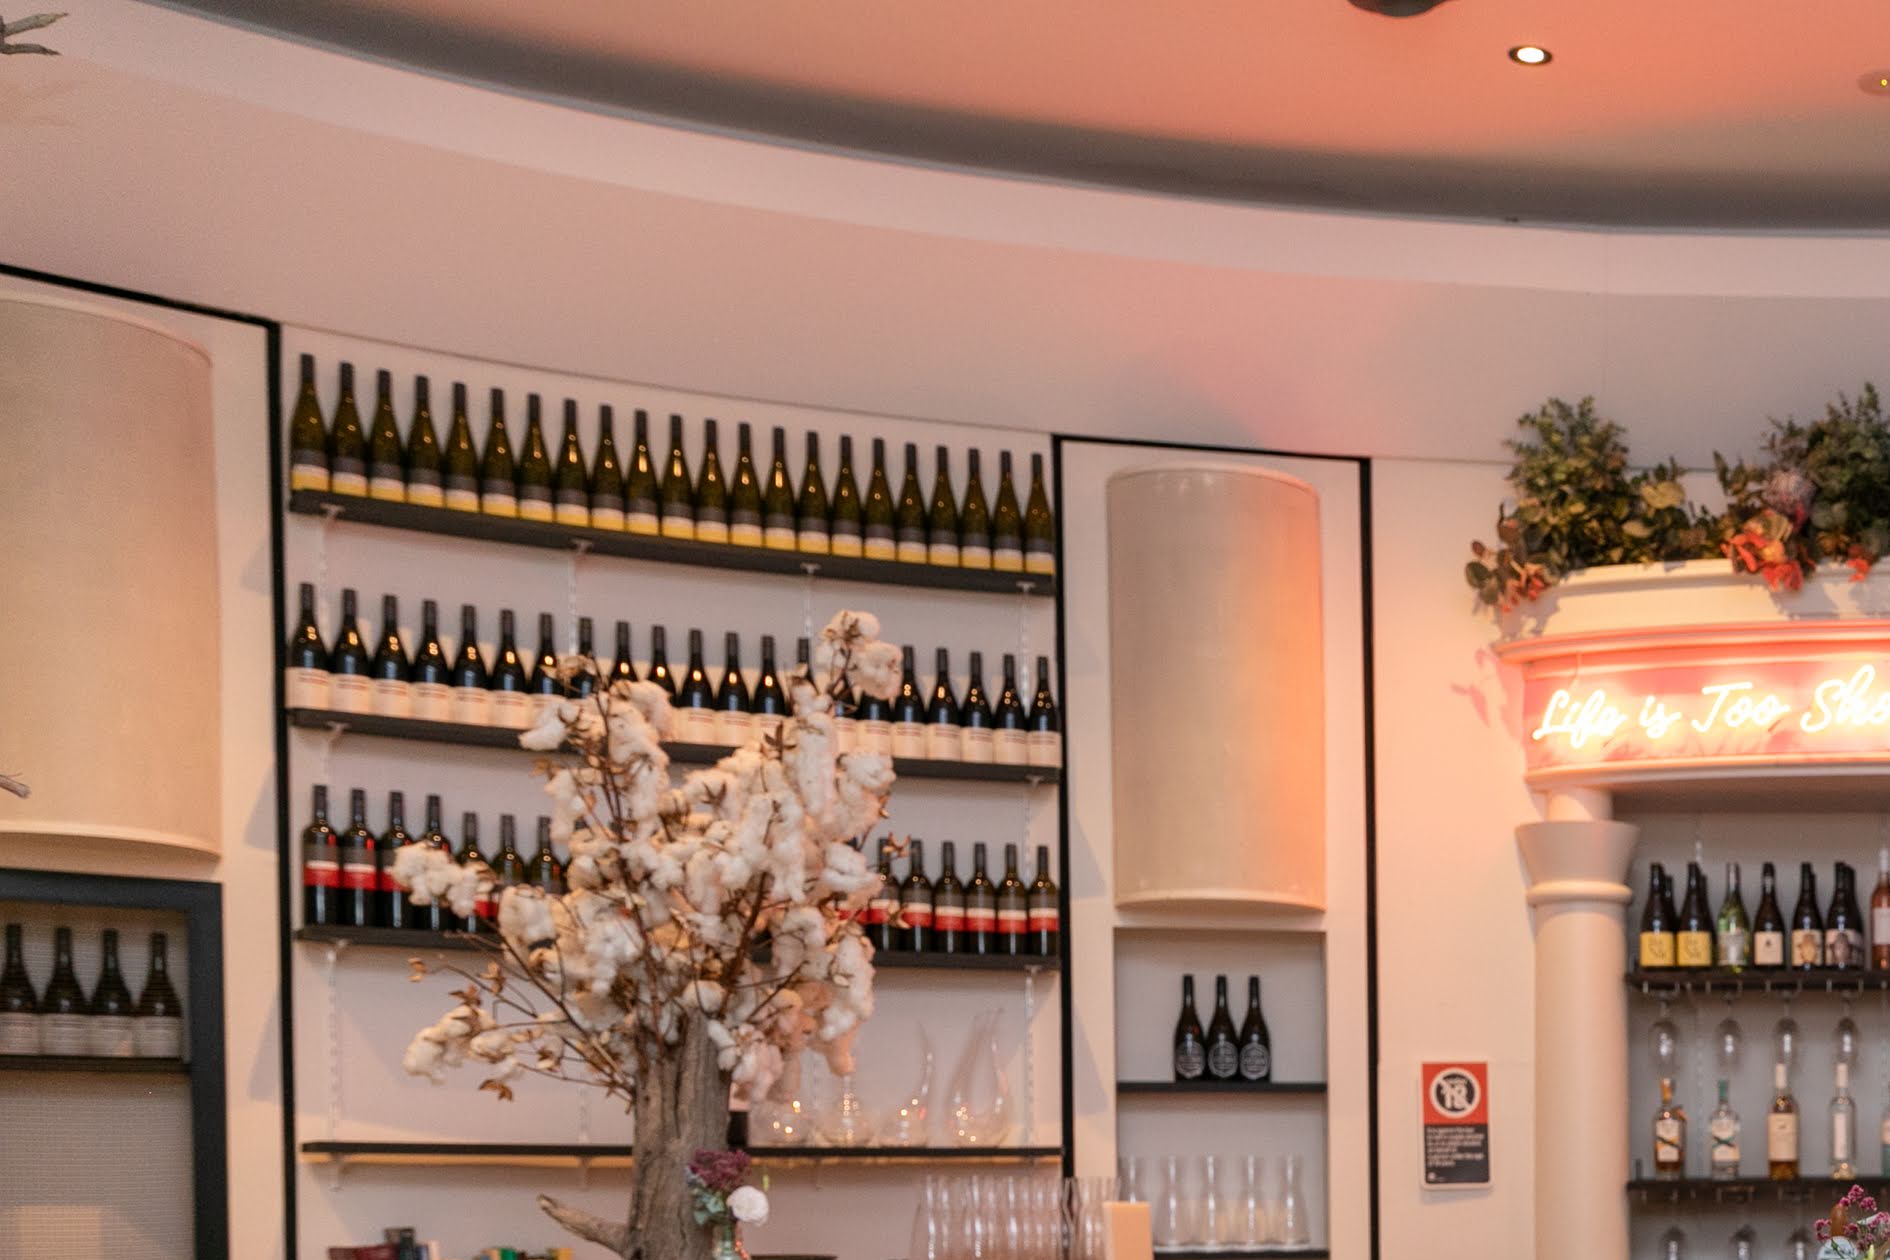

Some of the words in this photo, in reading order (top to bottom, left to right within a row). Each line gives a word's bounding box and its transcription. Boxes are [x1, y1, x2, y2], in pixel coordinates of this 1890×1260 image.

[1532, 689, 1628, 748] Life
[1638, 695, 1683, 739] is
[1691, 681, 1791, 733] Too
